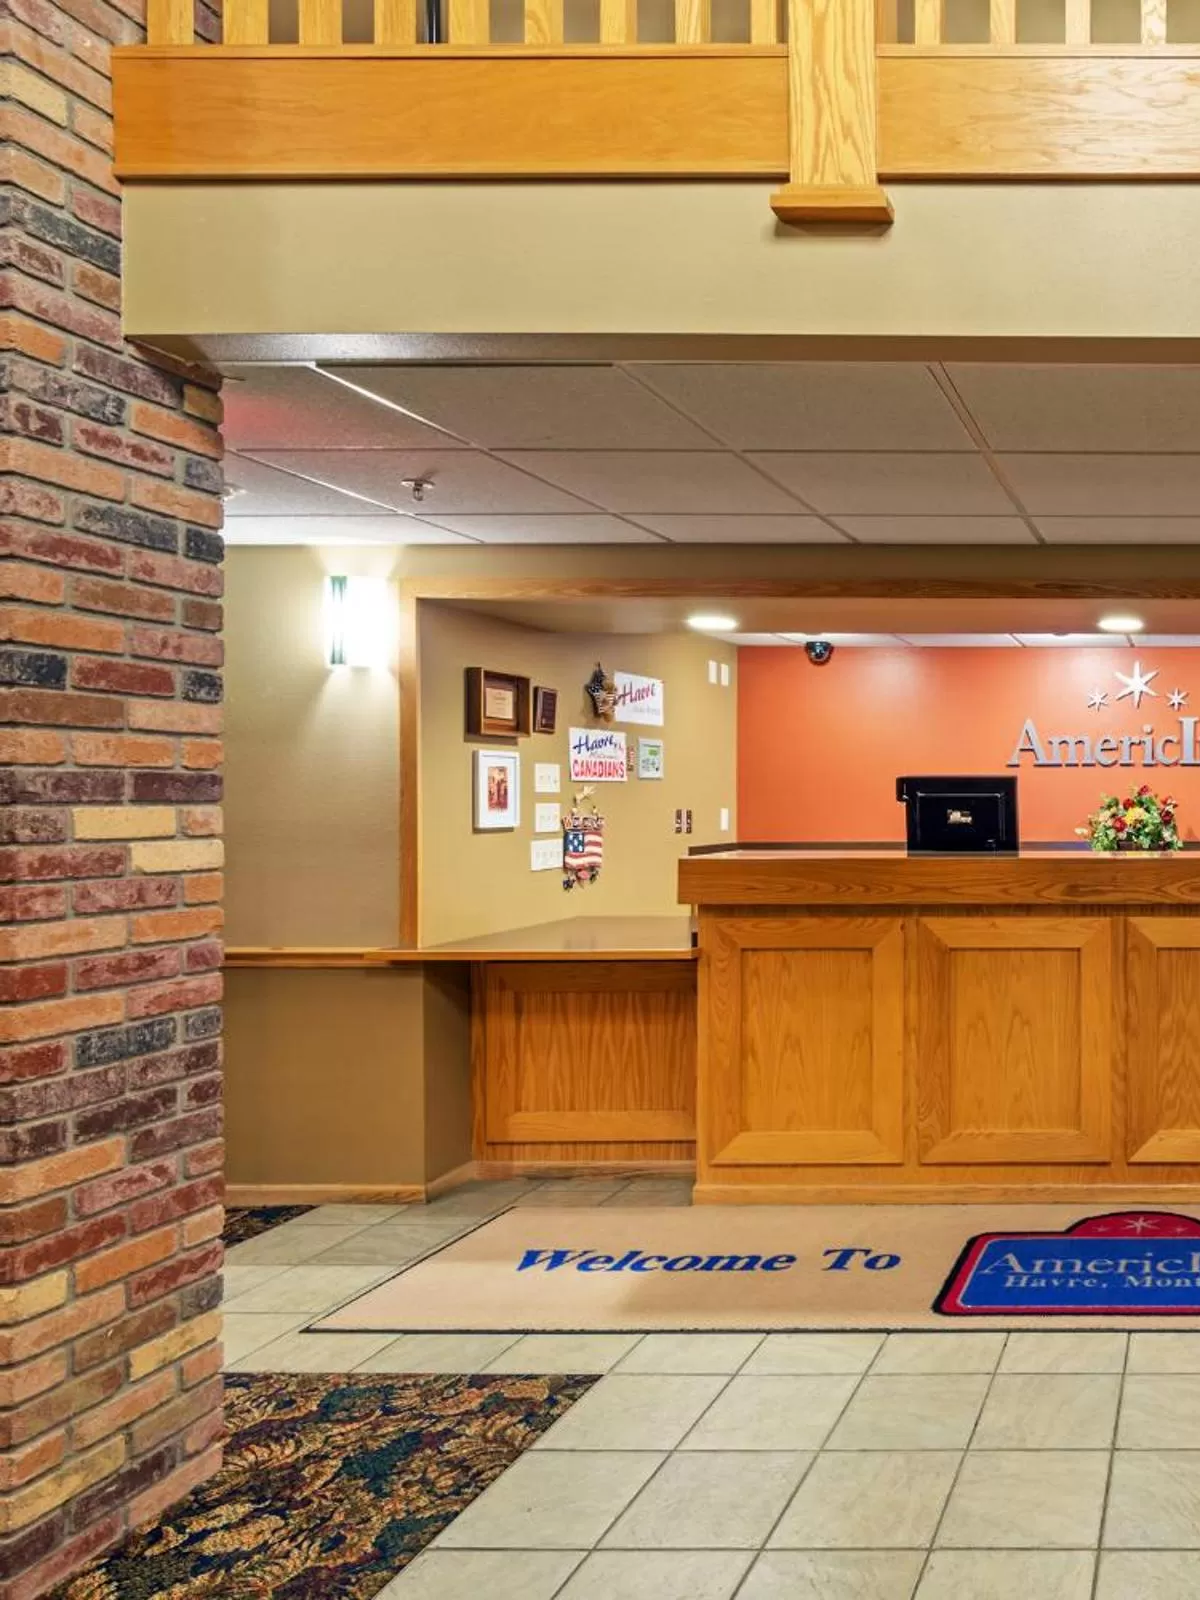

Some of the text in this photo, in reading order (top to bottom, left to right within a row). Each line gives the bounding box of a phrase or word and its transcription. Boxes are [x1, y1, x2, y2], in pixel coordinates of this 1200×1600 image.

[572, 759, 625, 779] CANADIANS
[515, 1248, 901, 1273] Welcome To
[1003, 1275, 1108, 1289] Havre,
